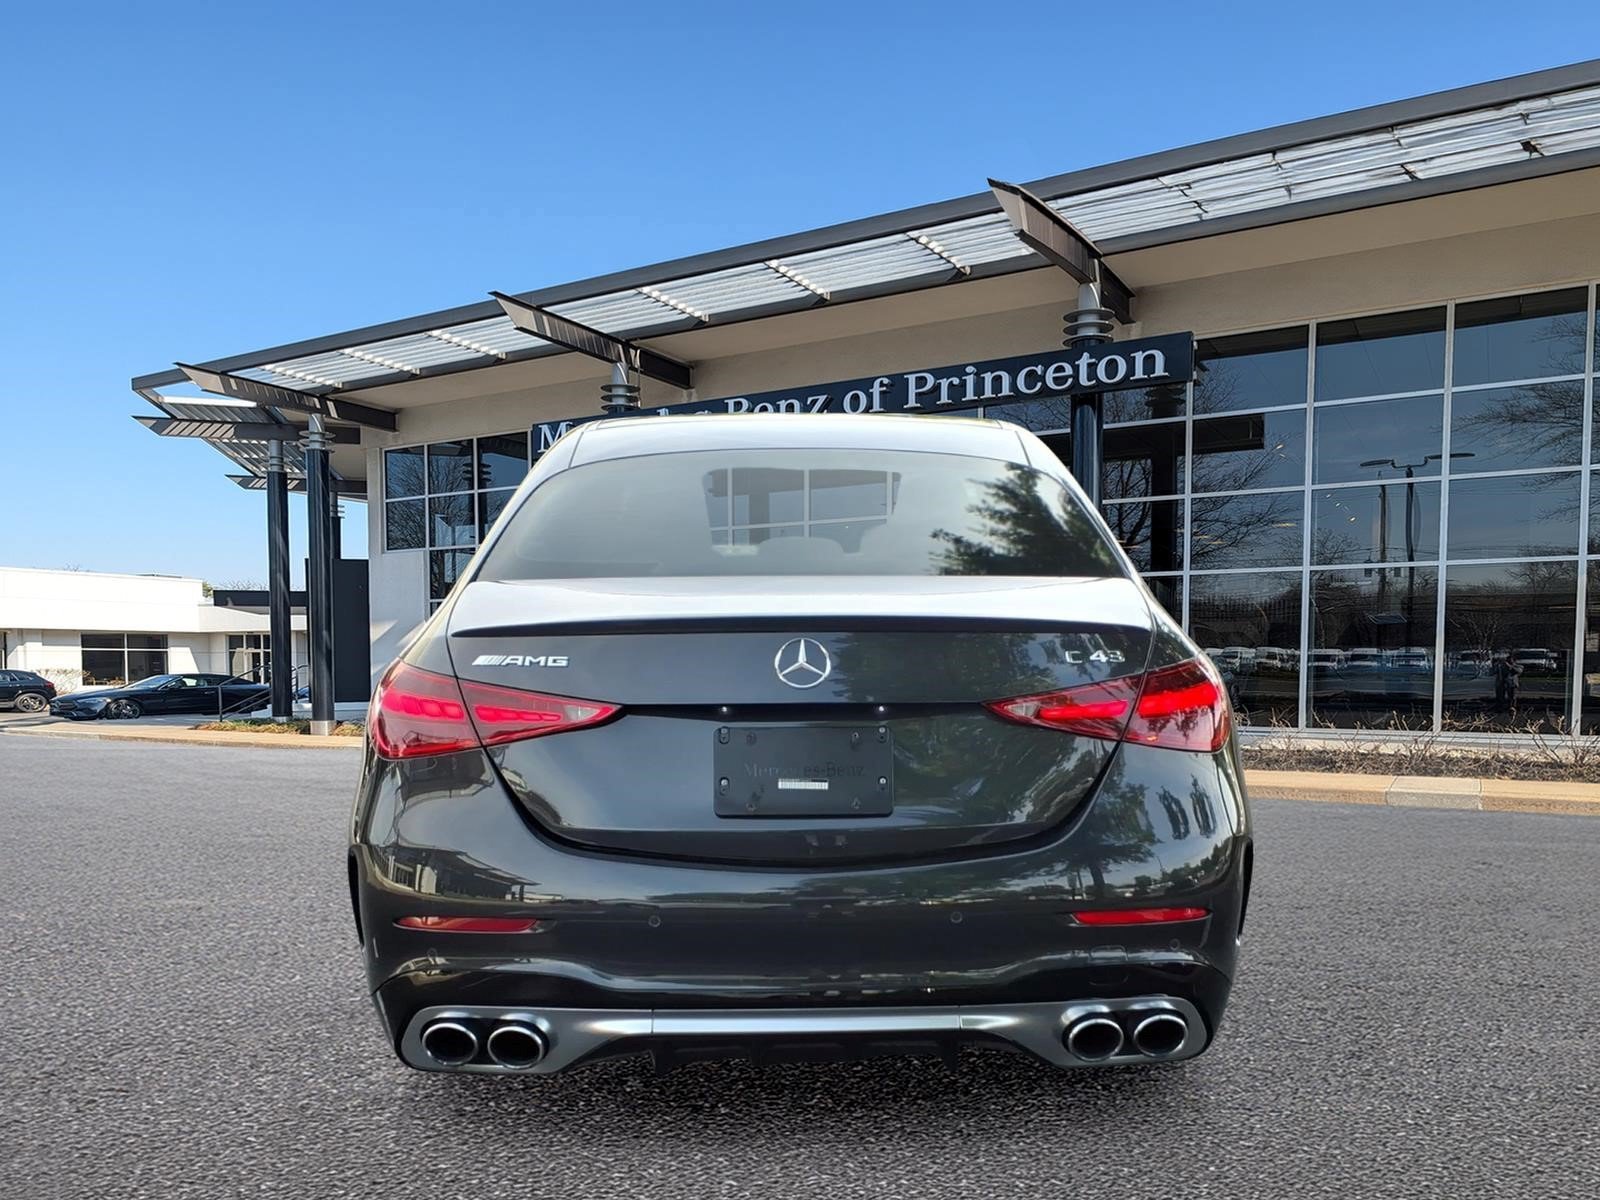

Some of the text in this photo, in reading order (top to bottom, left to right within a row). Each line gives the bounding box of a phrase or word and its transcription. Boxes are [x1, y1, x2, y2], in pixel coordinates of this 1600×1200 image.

[842, 377, 891, 414] of
[903, 348, 1169, 409] Princeton
[501, 655, 569, 667] AMG
[1065, 650, 1126, 663] C 43
